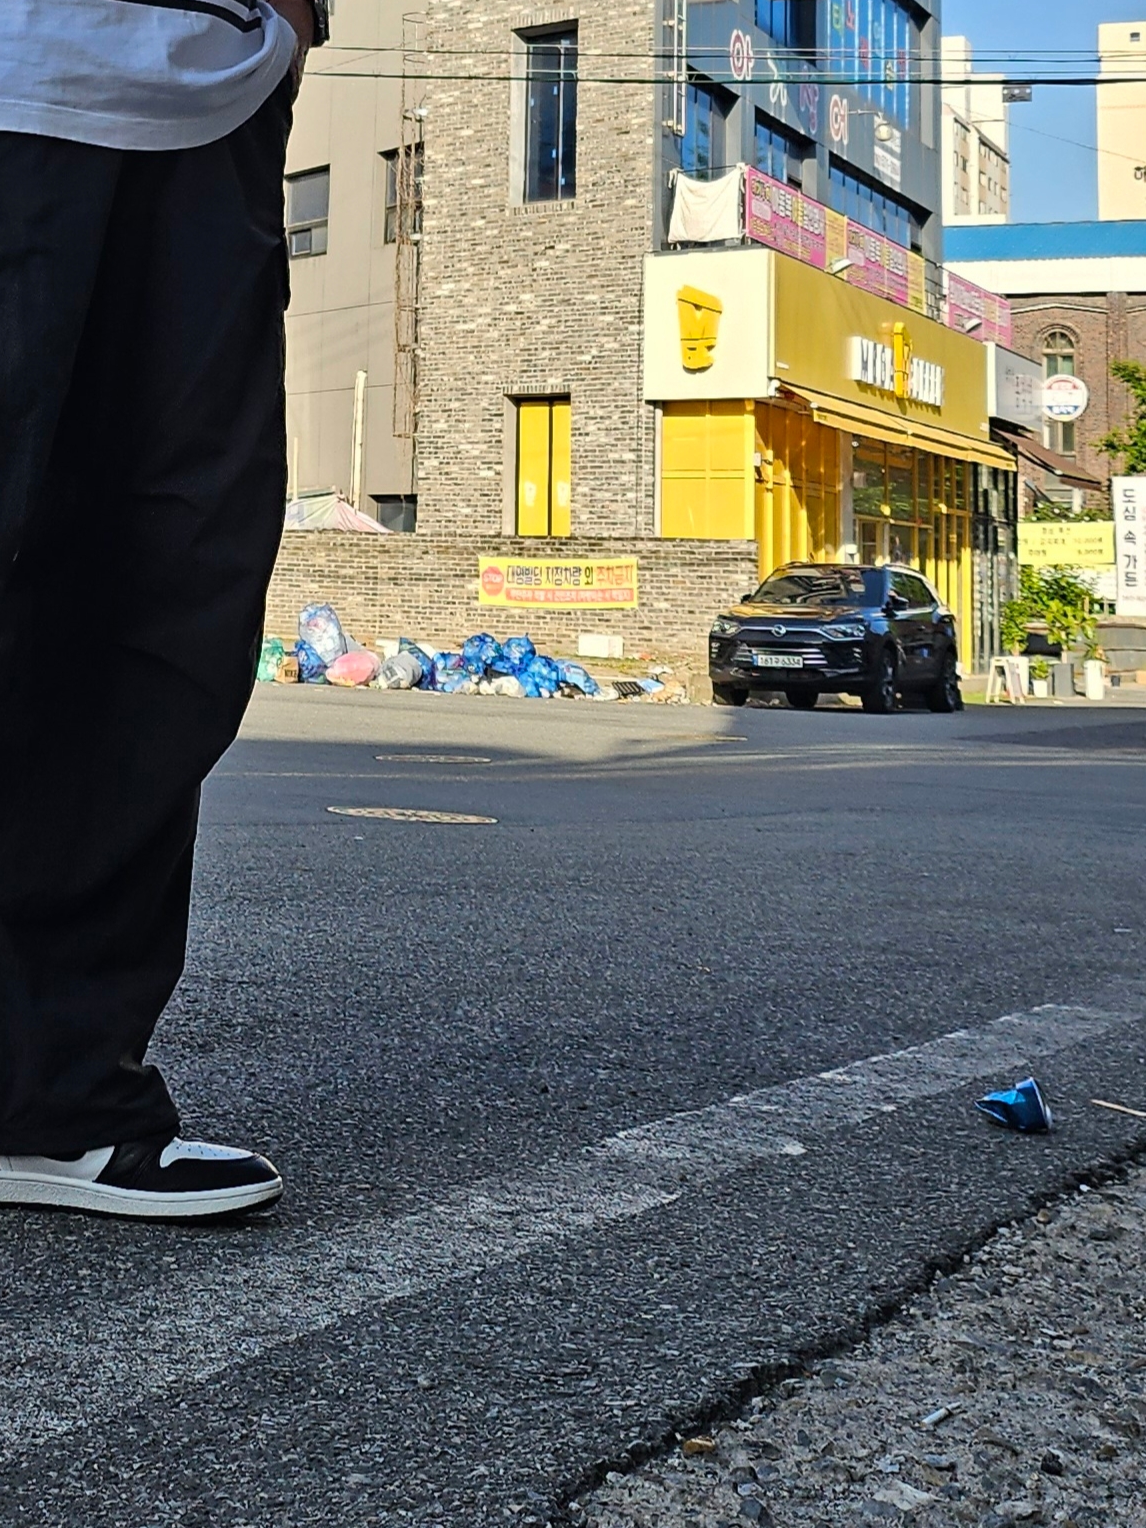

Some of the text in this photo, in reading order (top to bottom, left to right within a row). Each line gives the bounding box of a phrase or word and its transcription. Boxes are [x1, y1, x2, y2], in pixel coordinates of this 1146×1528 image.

[1122, 488, 1137, 521] 도심
[584, 565, 594, 586] 외
[1124, 554, 1138, 587] 가든
